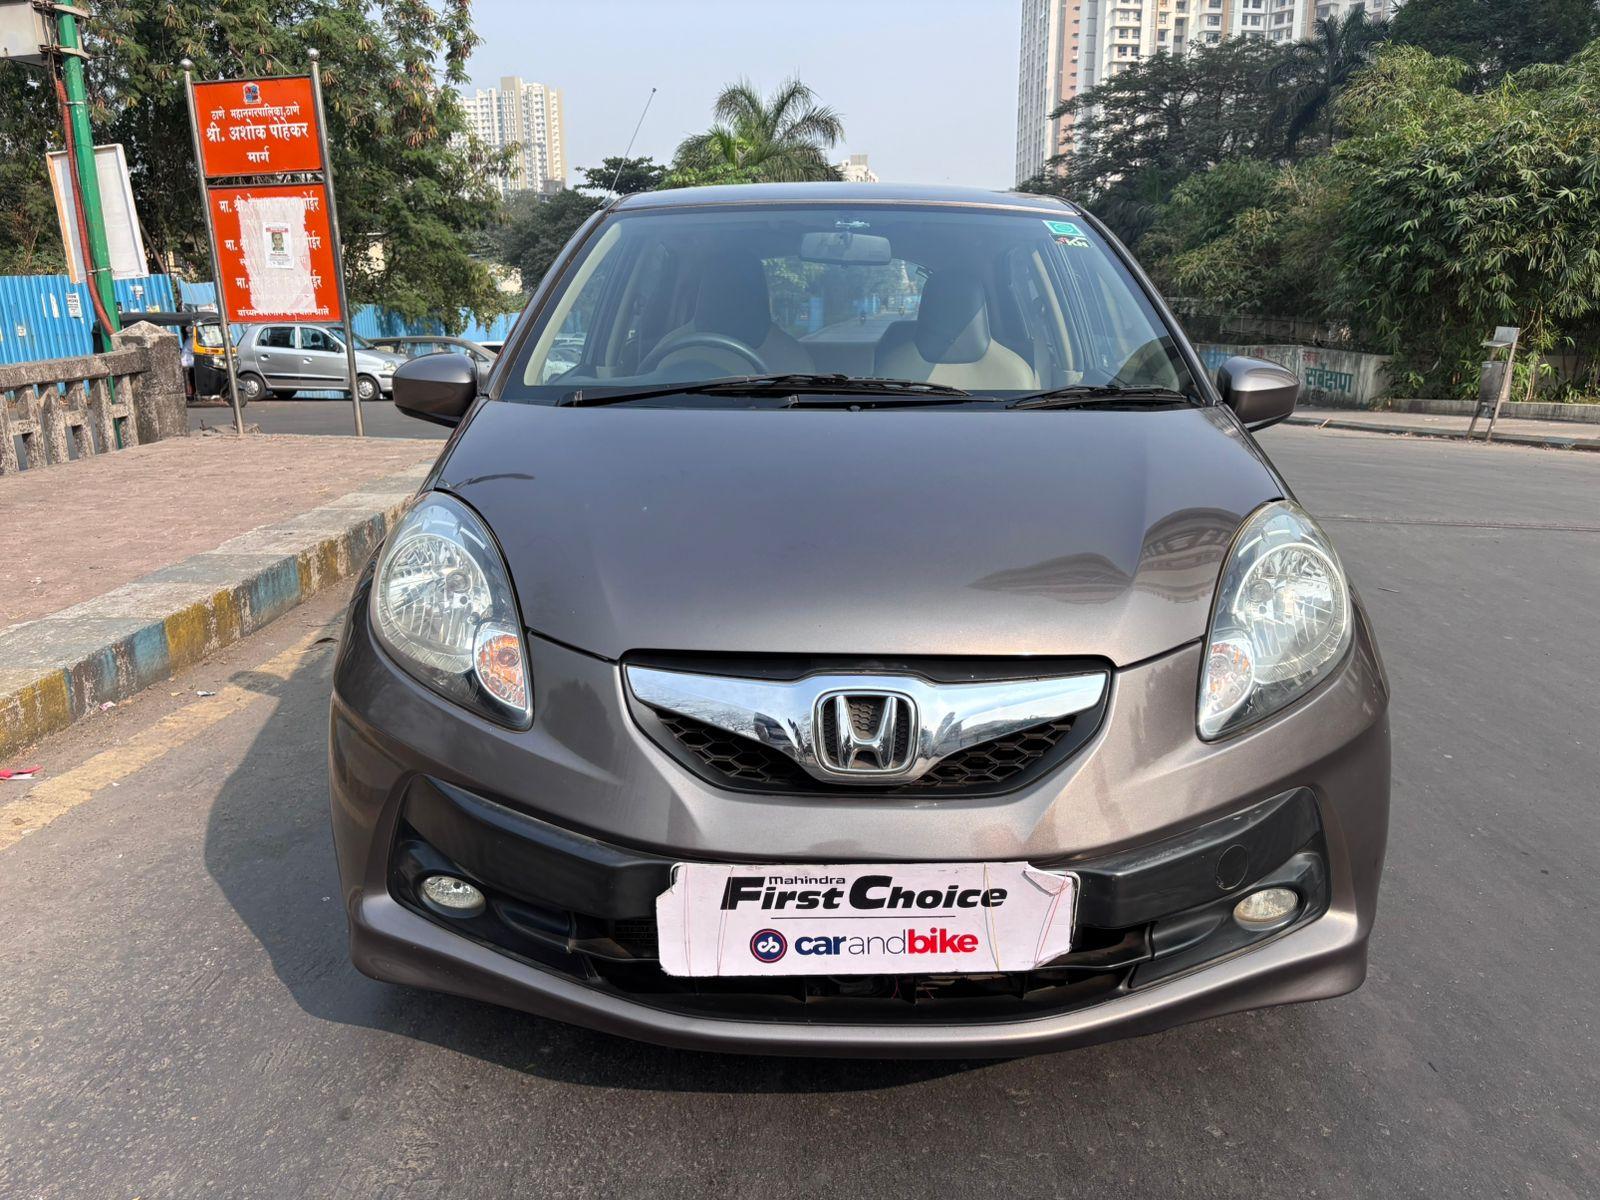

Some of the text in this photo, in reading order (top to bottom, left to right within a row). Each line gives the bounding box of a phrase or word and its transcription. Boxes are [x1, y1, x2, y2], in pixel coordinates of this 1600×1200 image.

[211, 106, 225, 120] ठाणे
[207, 116, 309, 143] श्री. अशोक पोहेकर
[246, 145, 269, 163] मार्ग
[768, 875, 846, 885] Mahindra
[720, 875, 1008, 911] First Choice
[794, 928, 979, 956] carandbike
